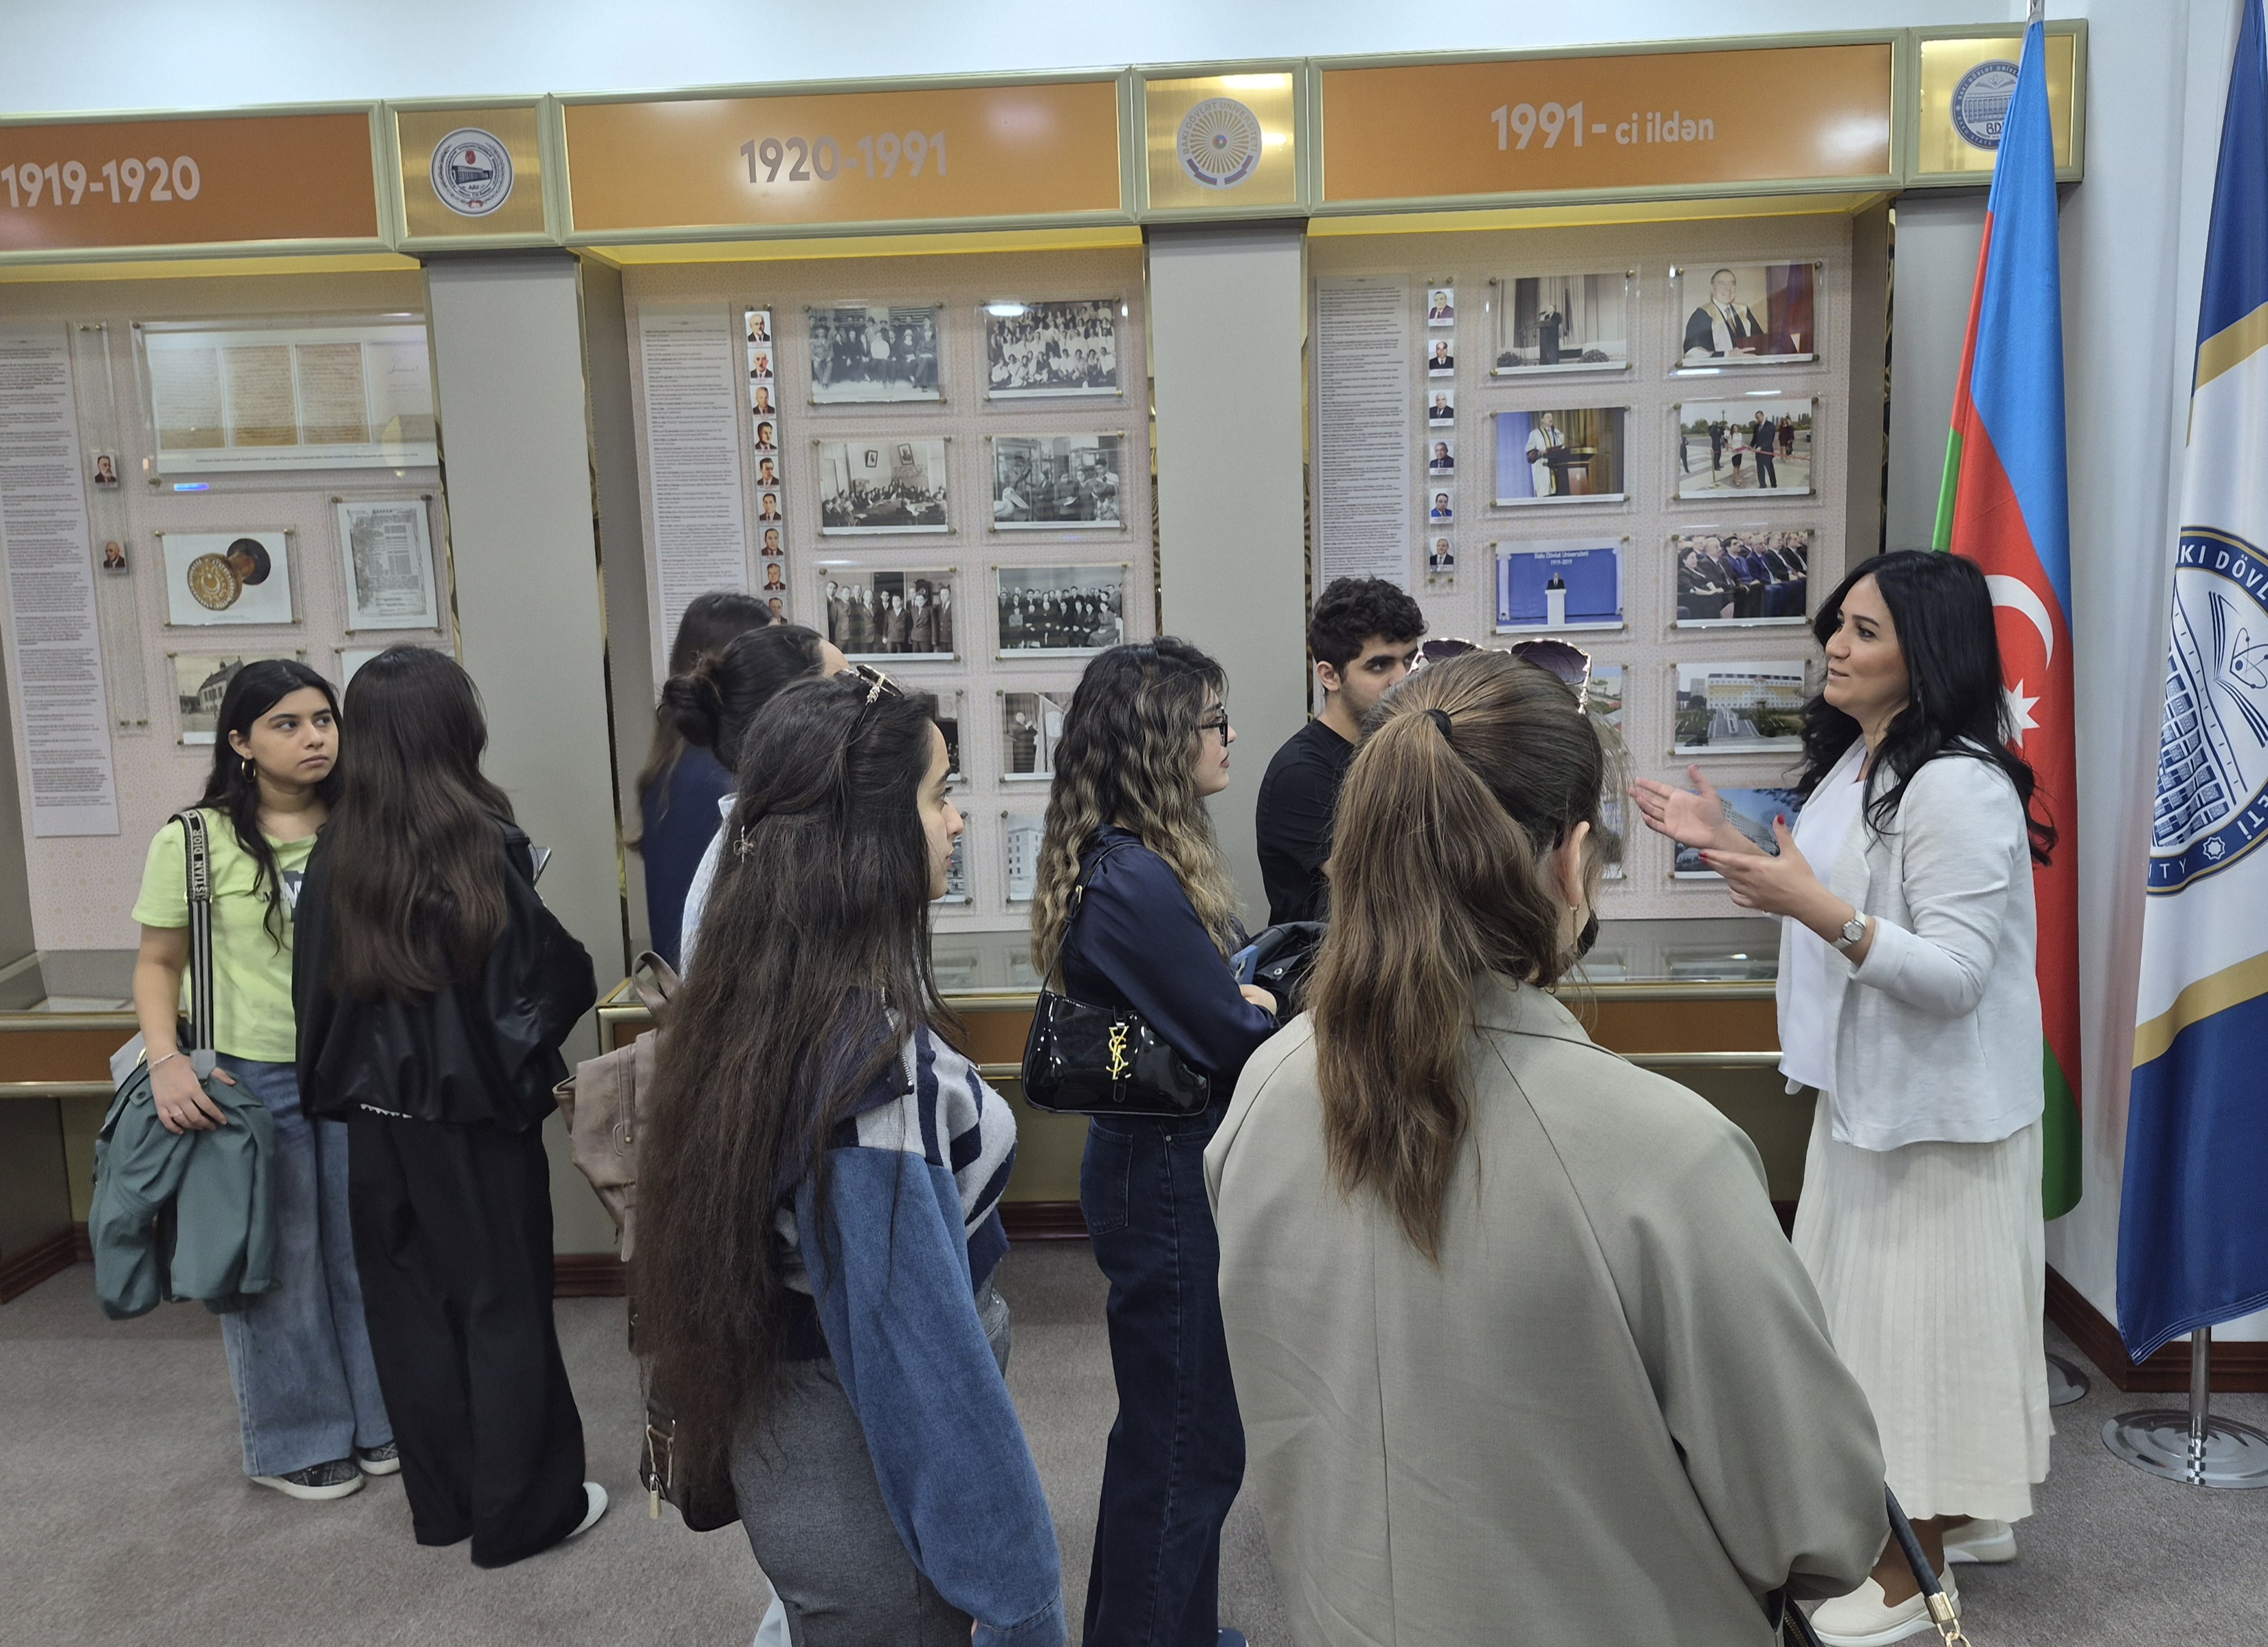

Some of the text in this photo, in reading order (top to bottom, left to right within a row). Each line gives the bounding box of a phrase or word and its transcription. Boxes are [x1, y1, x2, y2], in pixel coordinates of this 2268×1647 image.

[1647, 111, 1714, 143] ildən
[1986, 122, 2005, 135] BD
[740, 129, 948, 184] 1920-1991
[0, 155, 200, 208] 1919-1920
[192, 830, 204, 854] DIOR
